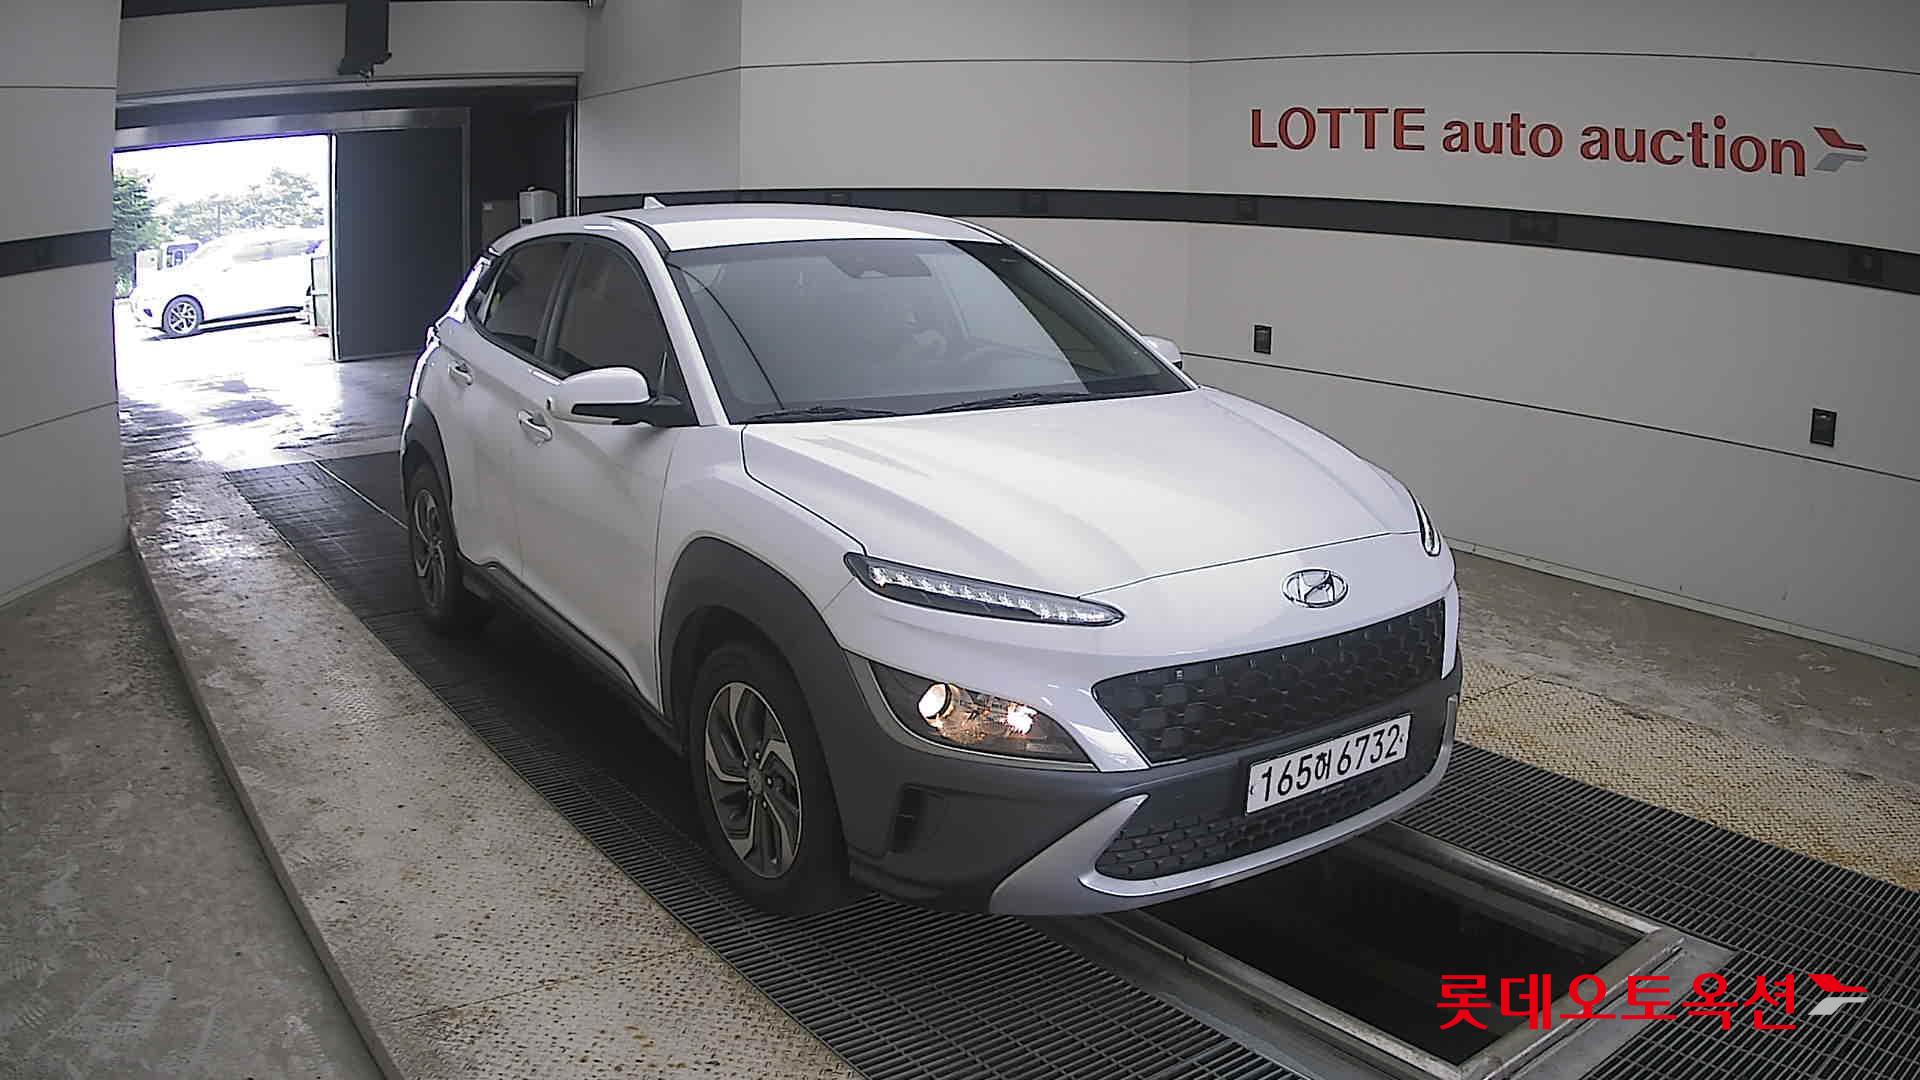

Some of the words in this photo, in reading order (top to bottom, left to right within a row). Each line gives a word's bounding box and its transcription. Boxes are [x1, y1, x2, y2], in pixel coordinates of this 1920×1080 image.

[1252, 107, 1426, 151] LOTTE
[1442, 112, 1564, 159] auto
[1579, 115, 1807, 178] auction
